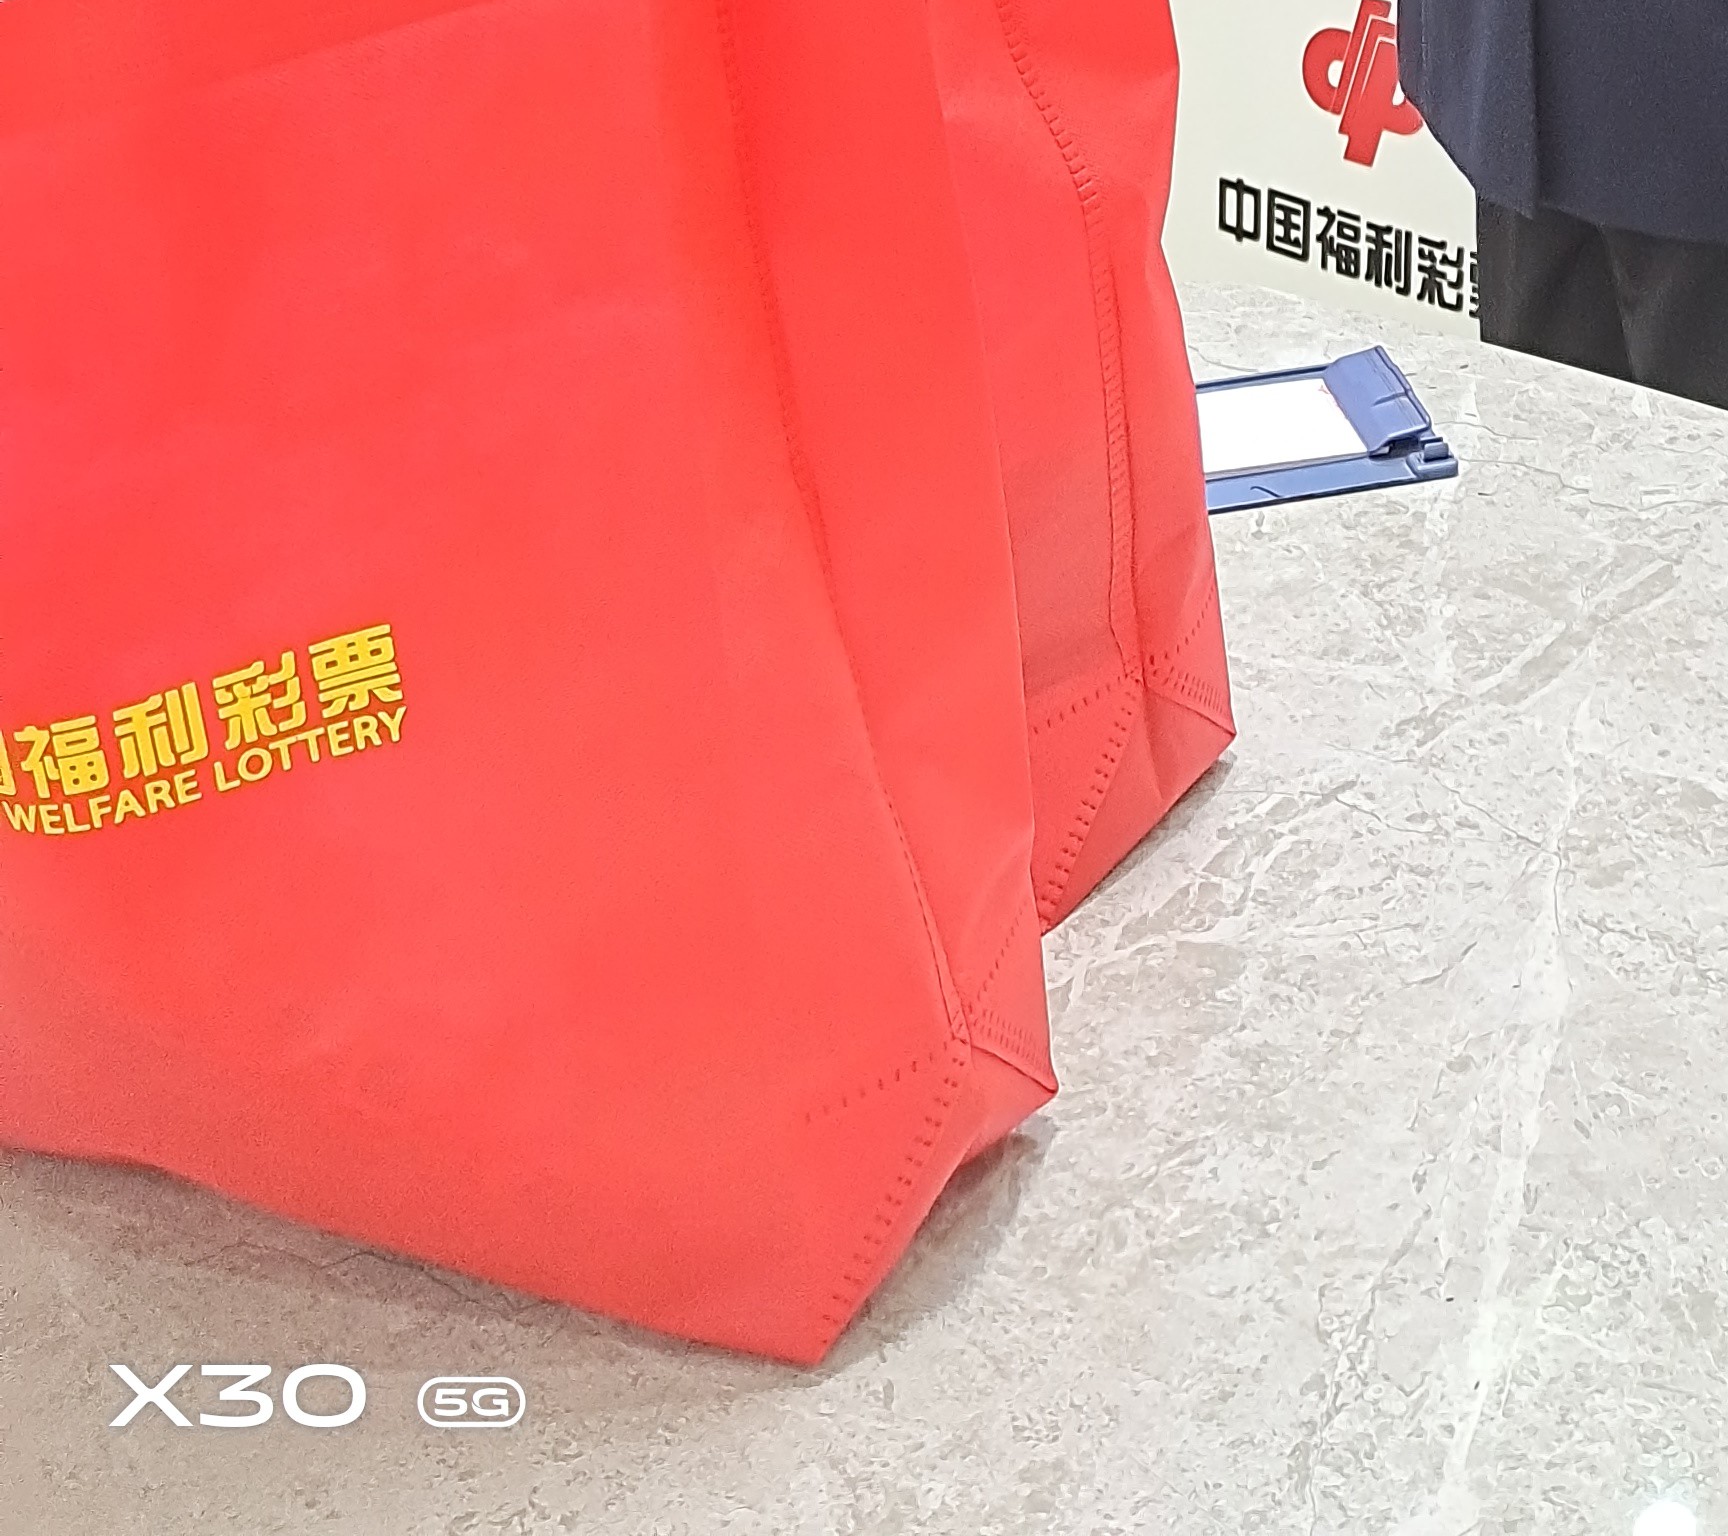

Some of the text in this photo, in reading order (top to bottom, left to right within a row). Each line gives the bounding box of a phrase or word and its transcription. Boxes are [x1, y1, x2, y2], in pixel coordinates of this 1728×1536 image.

[1218, 177, 1481, 318] 中国福利彩
[0, 624, 403, 798] 福利彩票
[2, 706, 407, 835] WELFARE LOTTERY
